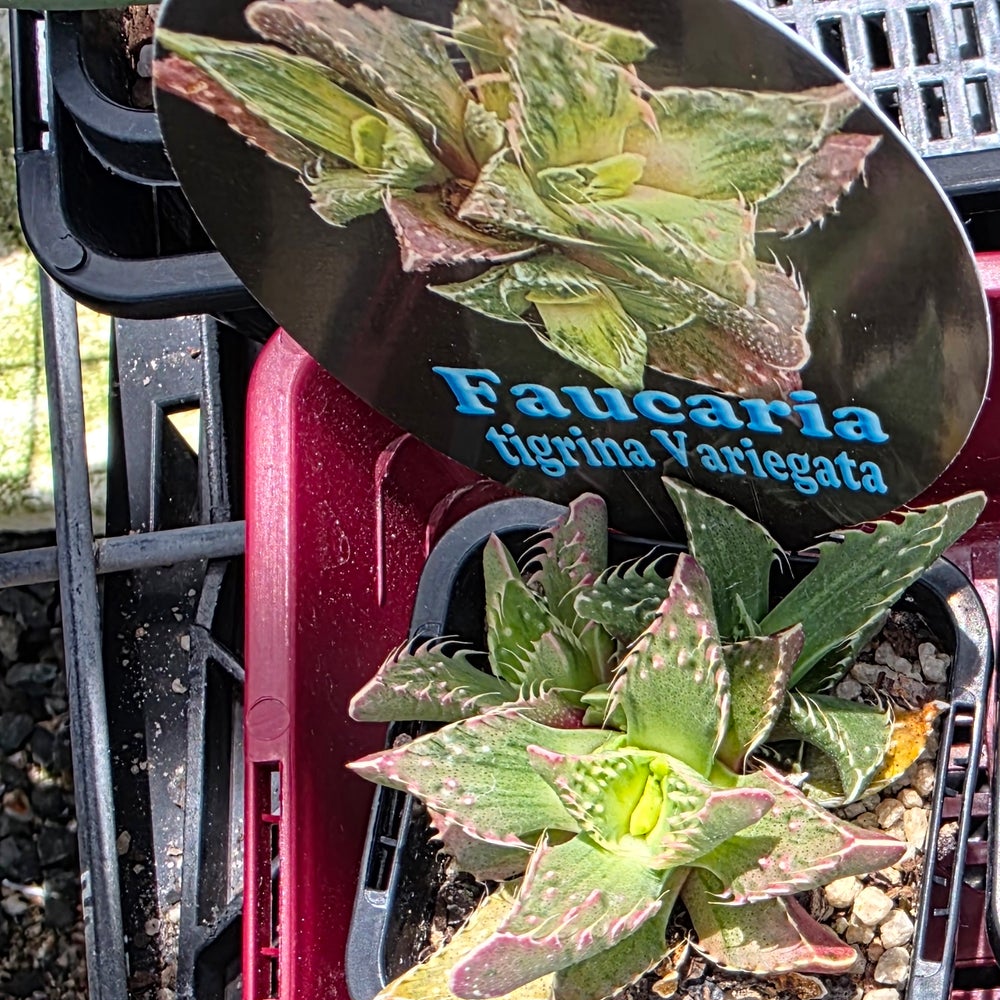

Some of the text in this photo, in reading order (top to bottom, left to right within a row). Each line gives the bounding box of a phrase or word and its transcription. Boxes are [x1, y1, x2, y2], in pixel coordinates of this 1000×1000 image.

[432, 367, 889, 443] Faucaria
[485, 424, 888, 495] tigrina Variegata
